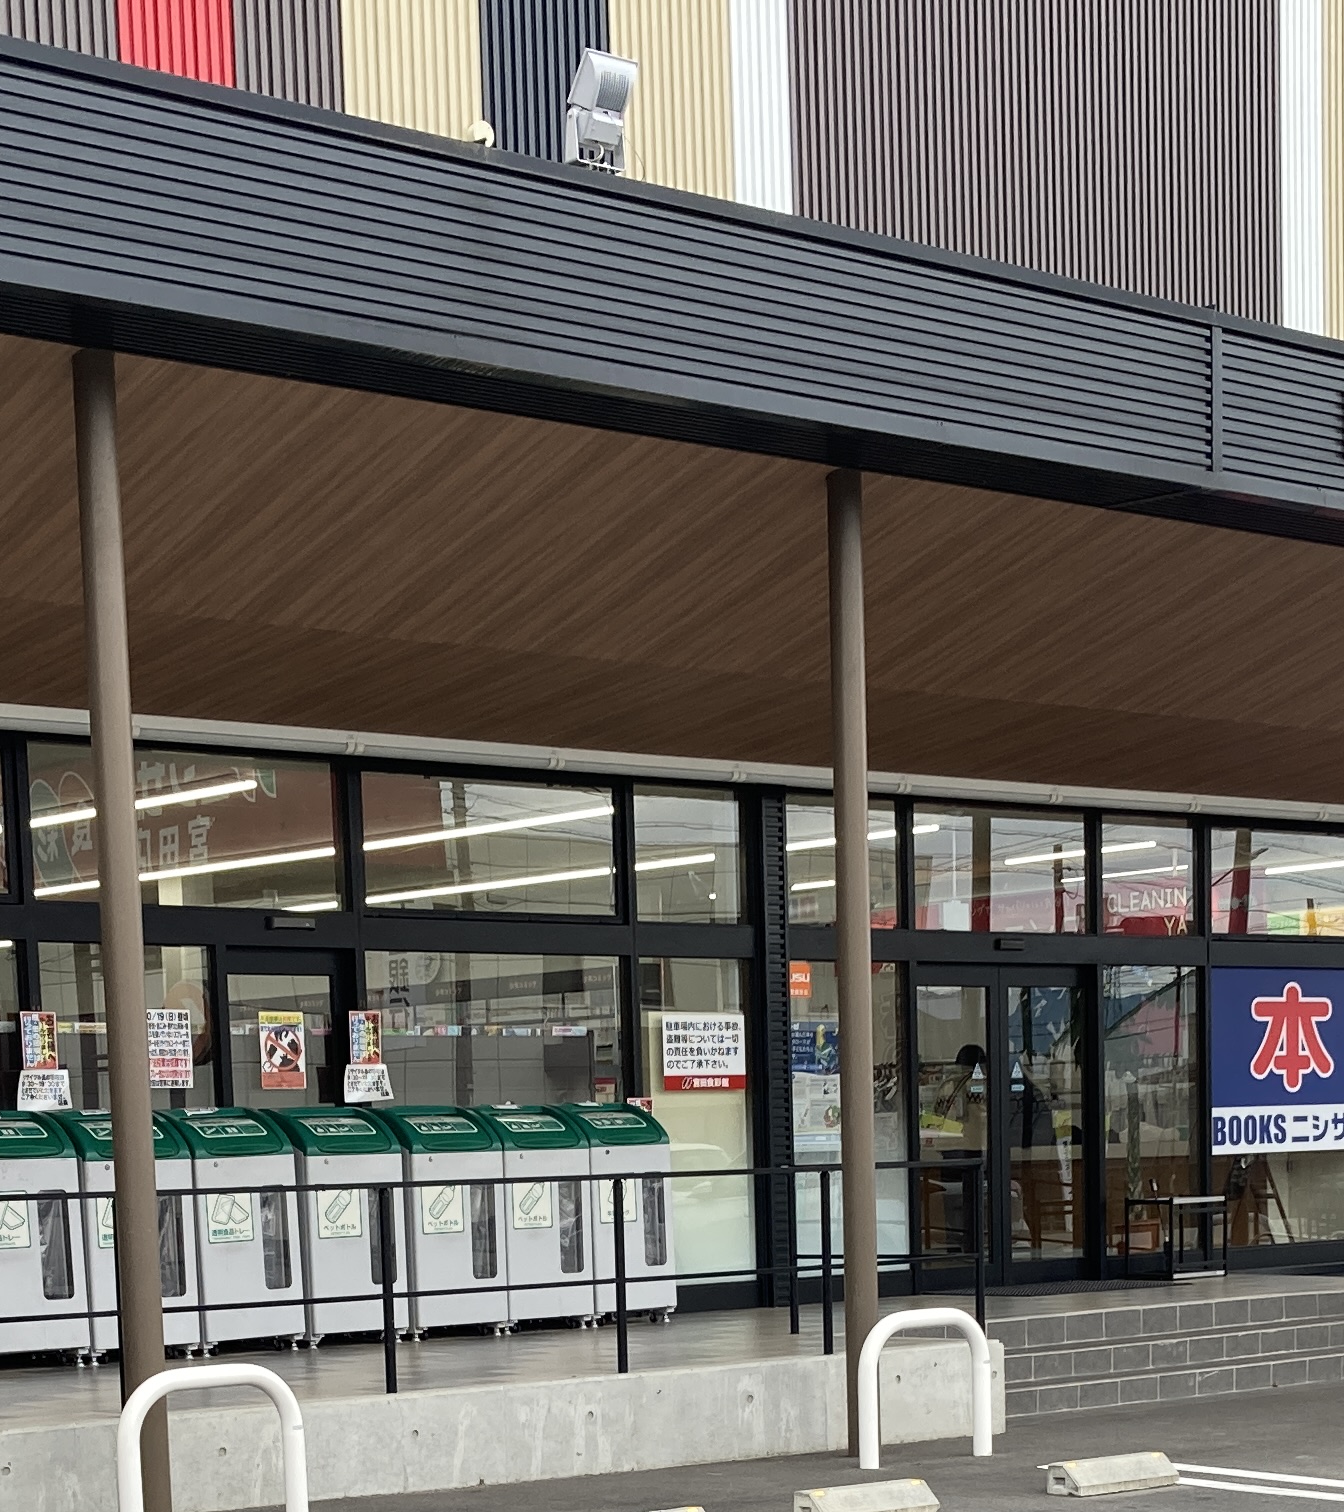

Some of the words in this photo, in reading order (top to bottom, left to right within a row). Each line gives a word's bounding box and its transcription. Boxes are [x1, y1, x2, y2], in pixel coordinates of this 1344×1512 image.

[666, 1021, 742, 1032] 駐車場内における事故、
[666, 1034, 739, 1044] 盗難等については一切
[1250, 981, 1334, 1093] 本
[666, 1046, 739, 1056] の責任を負いかねます
[667, 1059, 729, 1069] のでご了承下さい。
[1212, 1114, 1286, 1146] BOOKS
